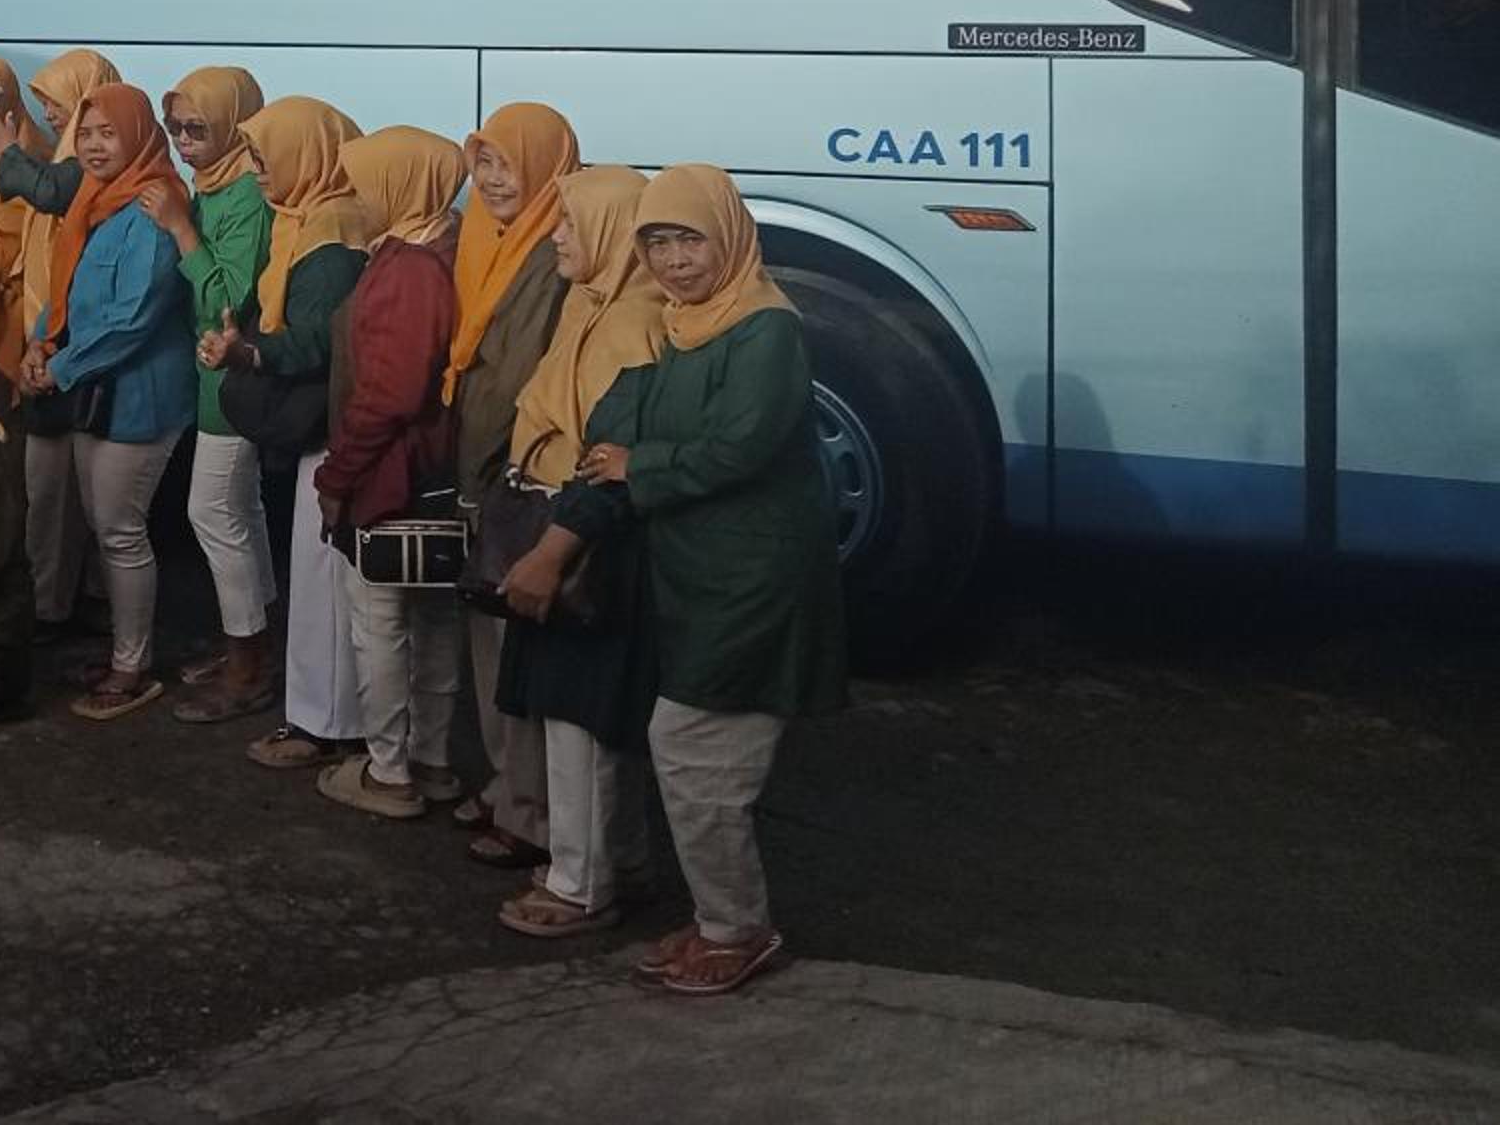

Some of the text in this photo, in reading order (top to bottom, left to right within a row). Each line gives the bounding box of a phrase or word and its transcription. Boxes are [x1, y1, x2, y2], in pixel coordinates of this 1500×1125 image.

[958, 26, 1137, 49] Mercedes-Benz
[827, 128, 1031, 168] CAA 111
